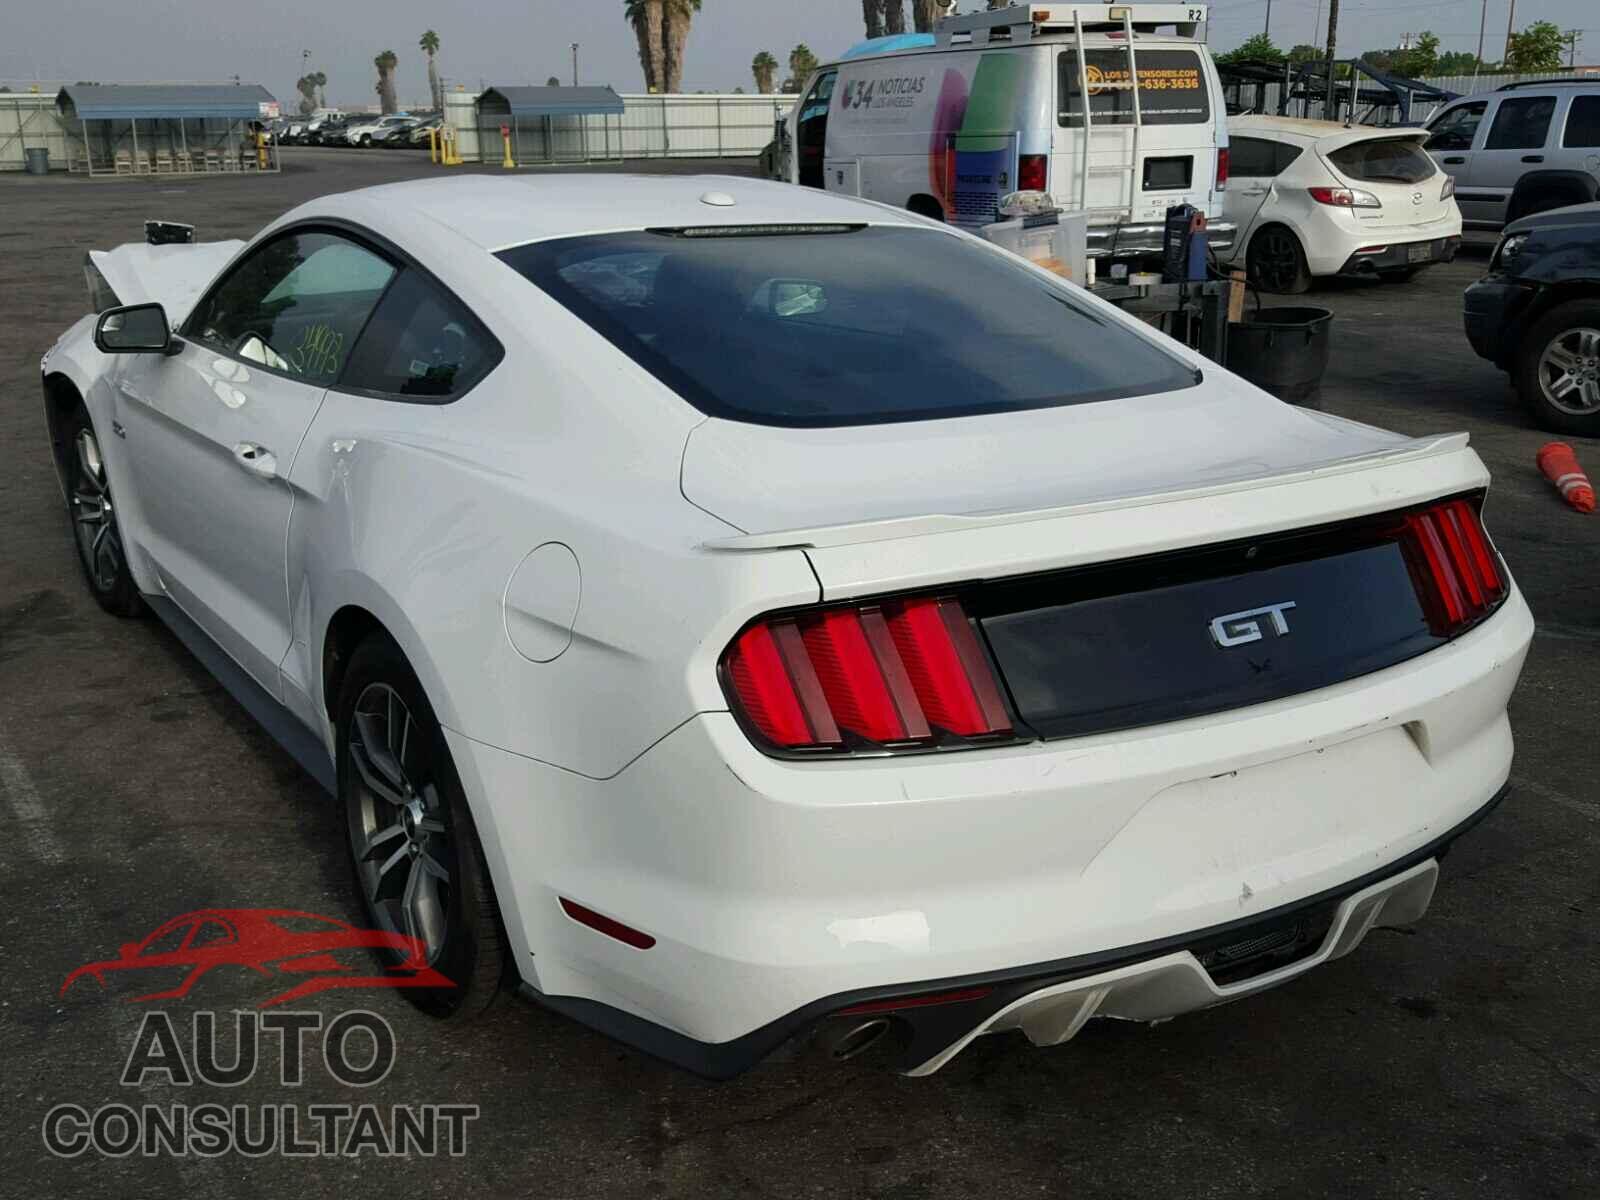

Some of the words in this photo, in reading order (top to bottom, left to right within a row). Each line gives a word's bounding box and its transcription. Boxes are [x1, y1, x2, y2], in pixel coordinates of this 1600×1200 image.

[1189, 9, 1202, 21] R2
[1122, 70, 1198, 79] DFENSORES.COM
[852, 80, 875, 109] 34
[878, 76, 925, 95] NOTICIAS
[1208, 601, 1297, 647] GT
